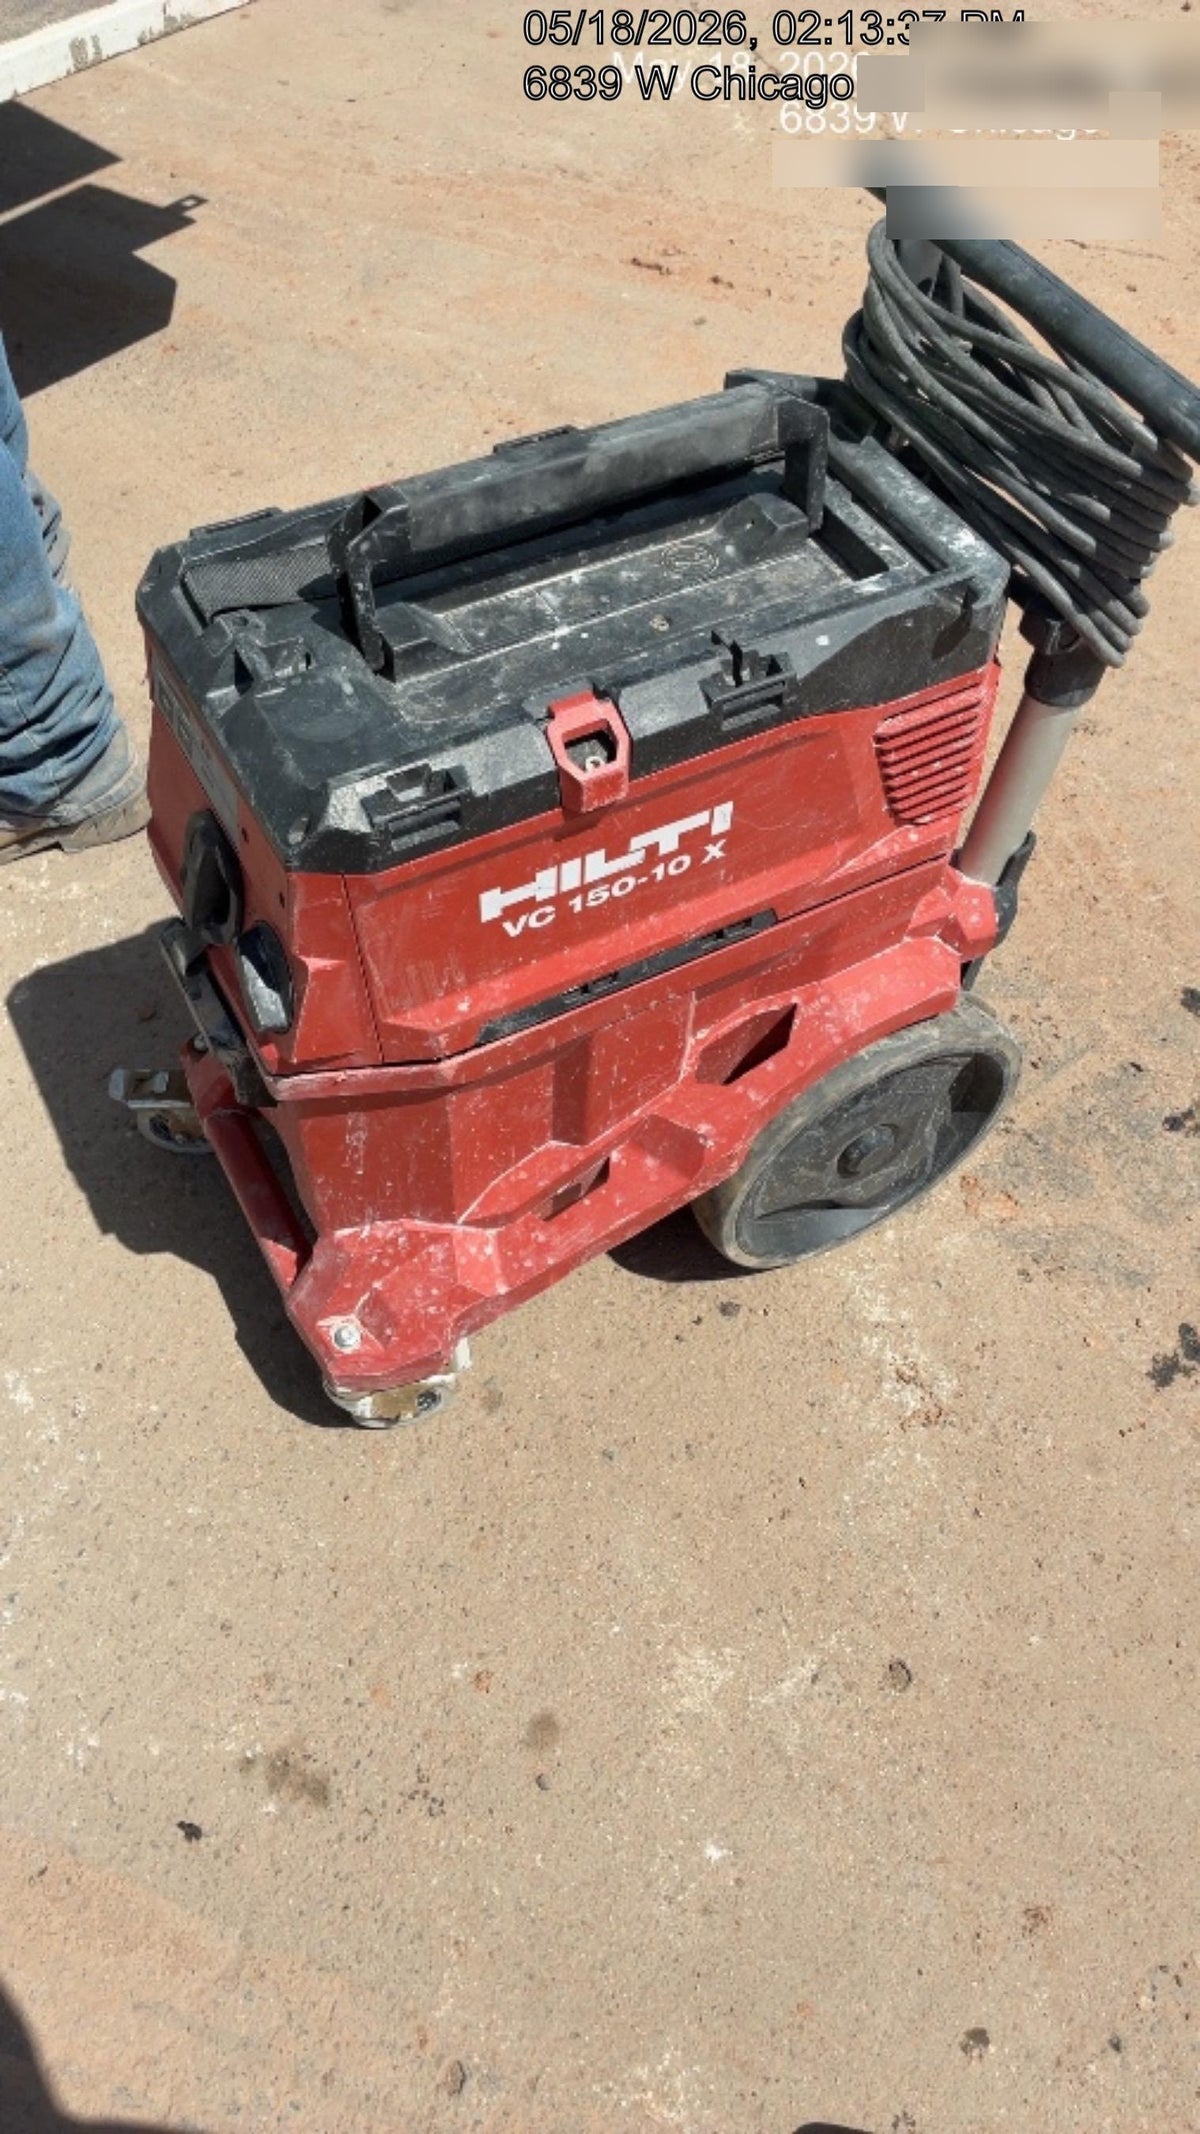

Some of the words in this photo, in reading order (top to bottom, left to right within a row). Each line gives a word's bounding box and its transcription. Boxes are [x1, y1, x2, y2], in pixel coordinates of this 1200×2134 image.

[479, 800, 735, 923] HILTI
[502, 905, 556, 938] VC
[568, 854, 692, 914] 150-10
[701, 838, 727, 865] X
